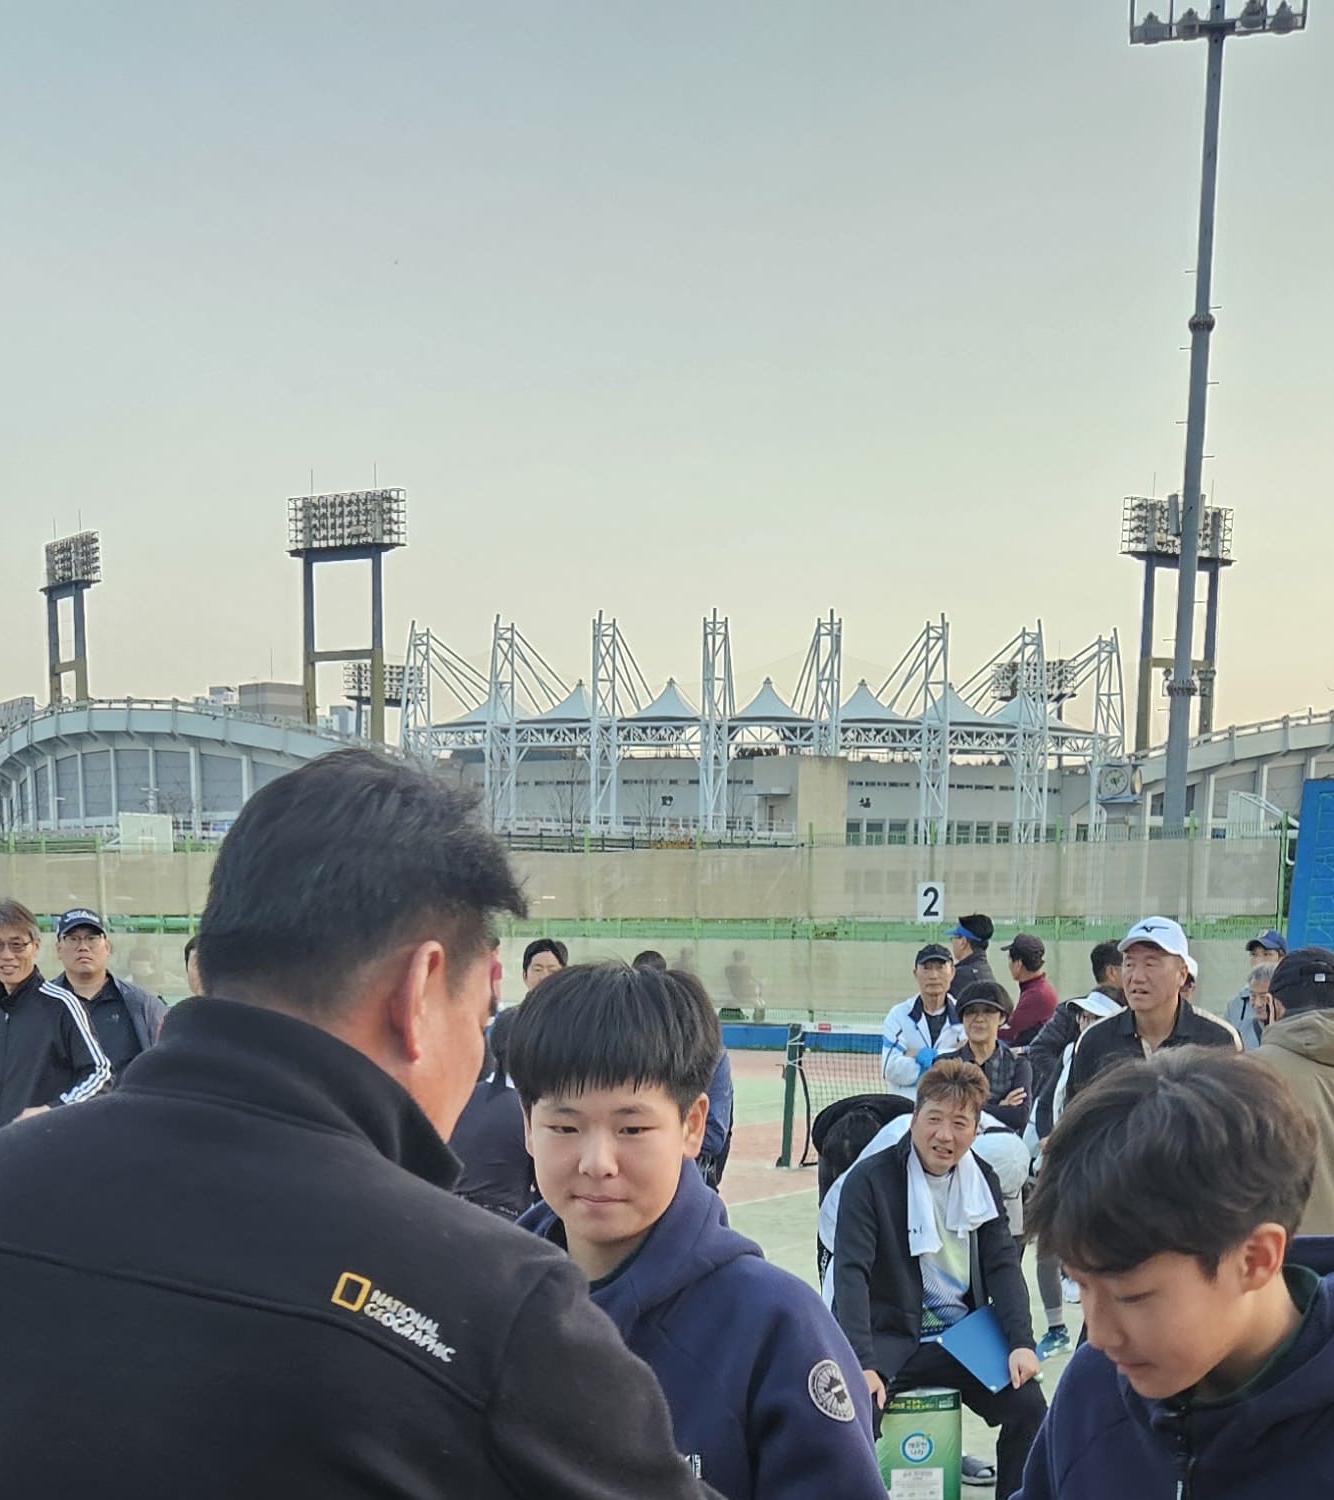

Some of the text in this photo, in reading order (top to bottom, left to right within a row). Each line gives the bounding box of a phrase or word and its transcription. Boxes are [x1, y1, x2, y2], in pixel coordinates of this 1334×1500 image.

[923, 886, 939, 917] 2
[364, 1303, 456, 1362] GEOGRAPHIC
[370, 1290, 439, 1338] NATIONAL
